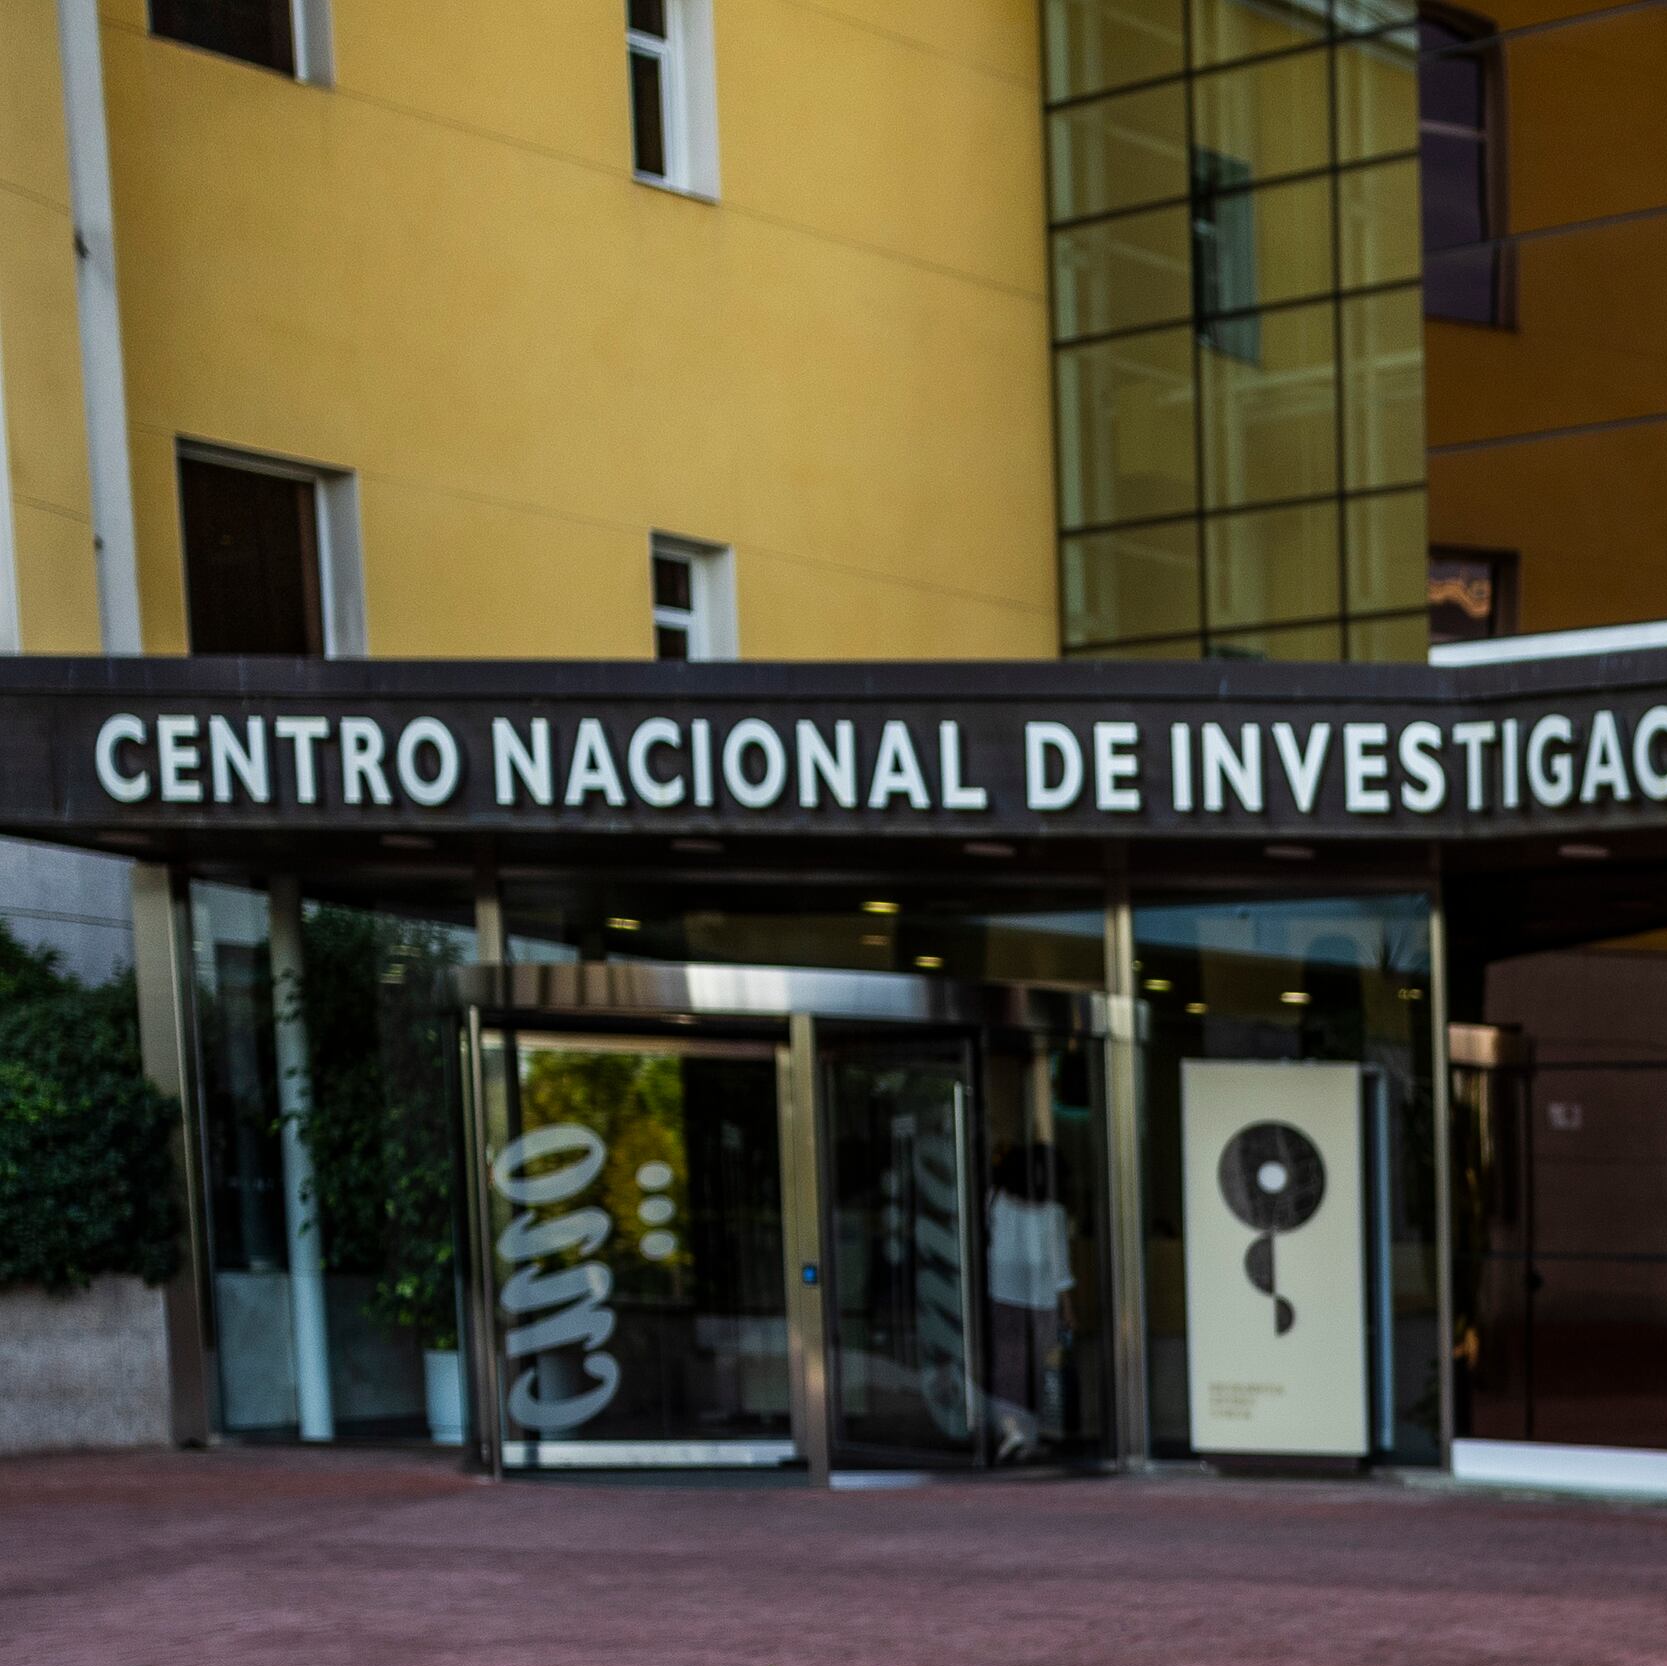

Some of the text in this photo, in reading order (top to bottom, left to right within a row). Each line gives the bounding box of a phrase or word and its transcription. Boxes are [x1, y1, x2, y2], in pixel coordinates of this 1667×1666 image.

[95, 713, 460, 806] CENTRO
[491, 716, 989, 810] NACIONAL
[1022, 720, 1142, 811] DE
